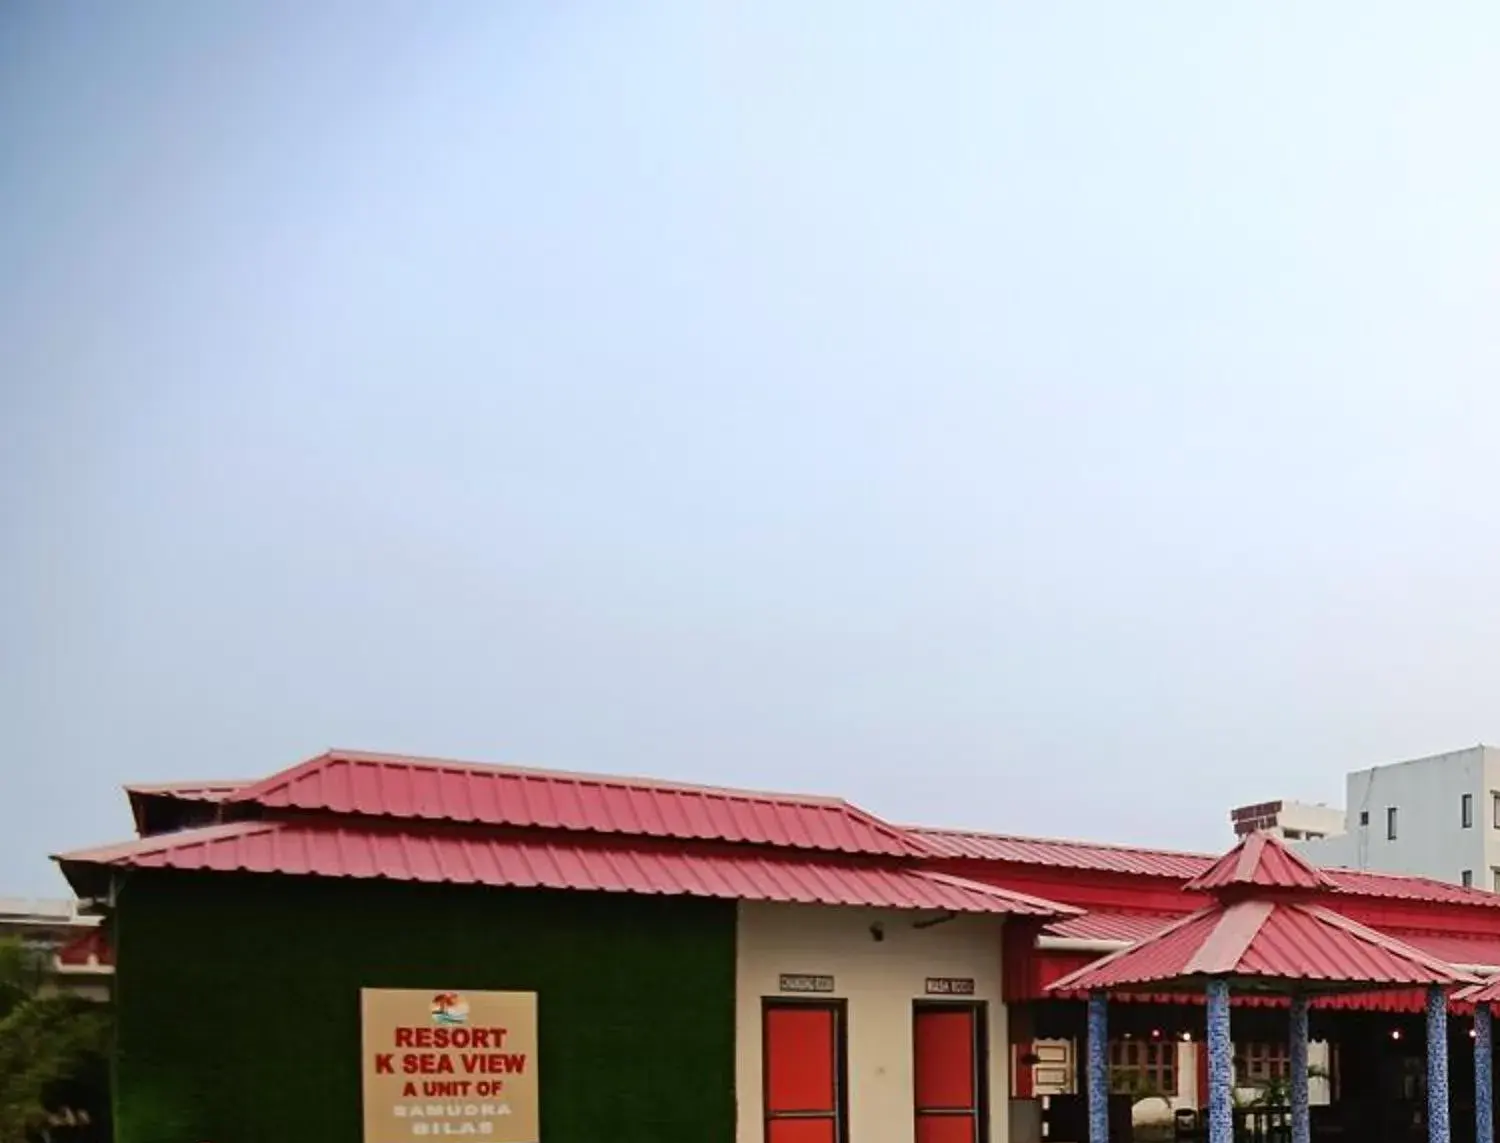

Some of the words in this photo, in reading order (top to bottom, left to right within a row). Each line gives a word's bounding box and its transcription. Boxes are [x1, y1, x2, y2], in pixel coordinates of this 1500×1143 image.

[394, 1027, 507, 1048] RESORT
[375, 1053, 394, 1074] K
[402, 1053, 454, 1074] SEA
[461, 1053, 526, 1074] VIEW
[402, 1081, 417, 1097] A
[423, 1081, 472, 1097] UNIT
[476, 1080, 503, 1096] OF
[393, 1103, 512, 1117] SAMUDRA
[411, 1121, 493, 1135] BILAS
